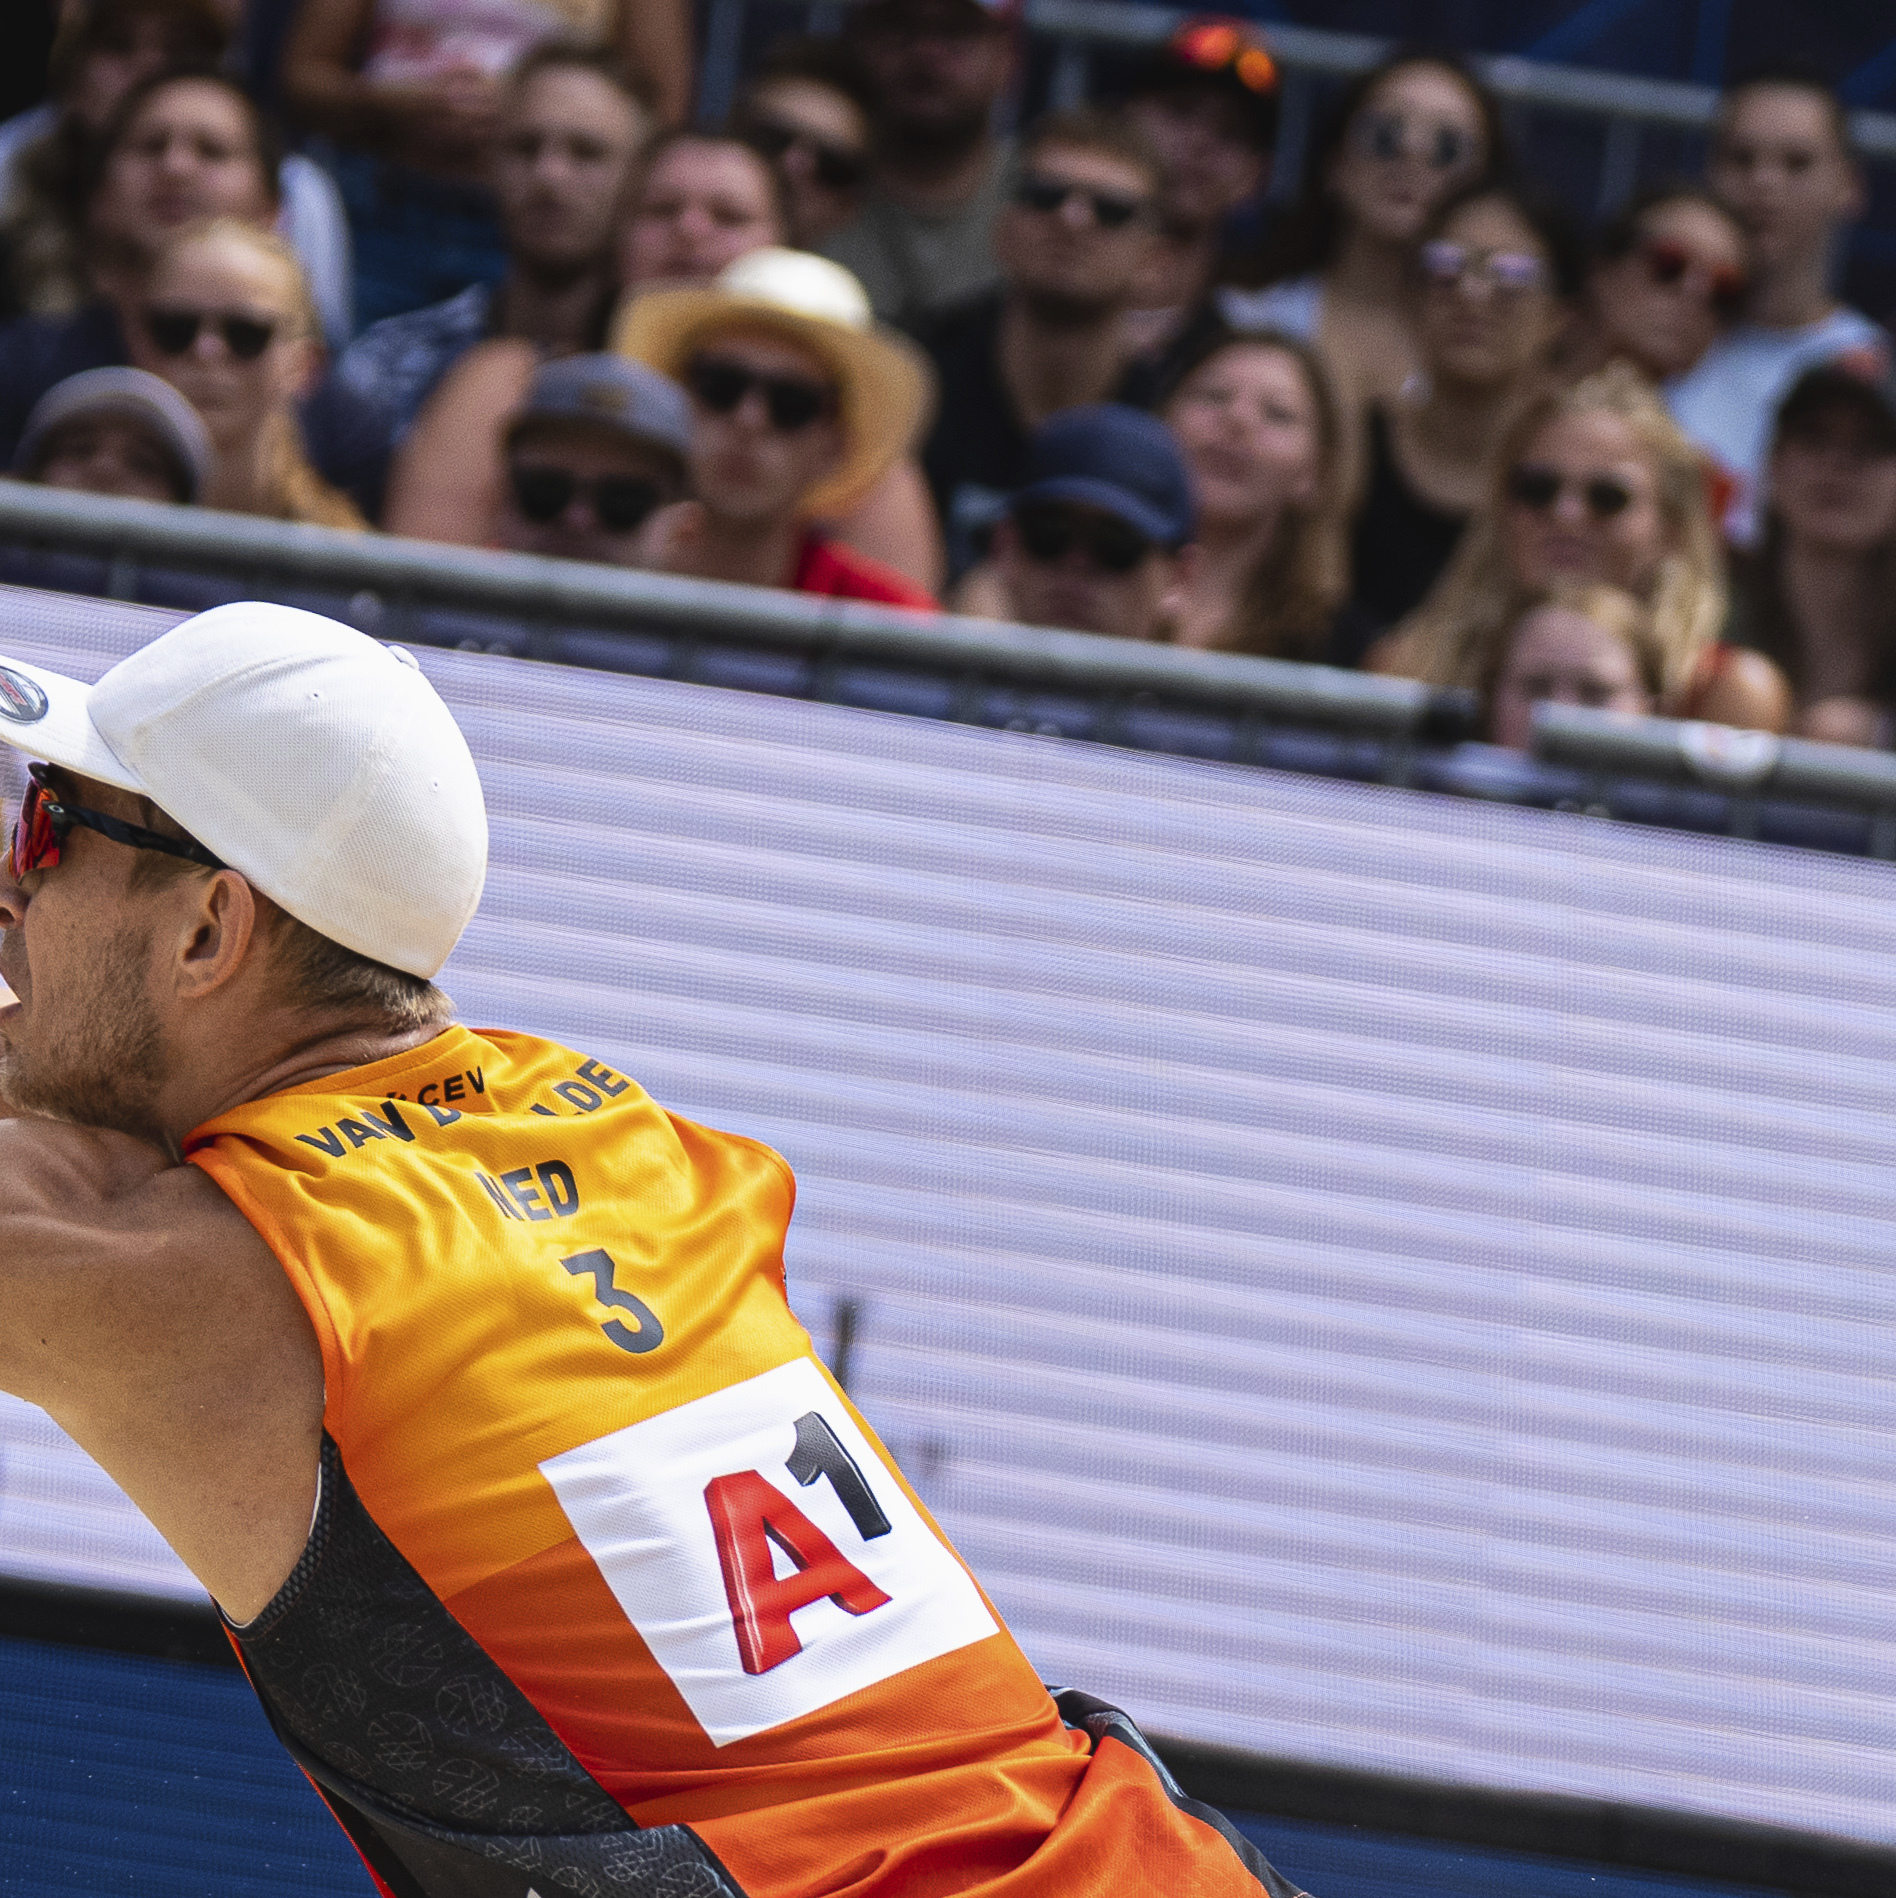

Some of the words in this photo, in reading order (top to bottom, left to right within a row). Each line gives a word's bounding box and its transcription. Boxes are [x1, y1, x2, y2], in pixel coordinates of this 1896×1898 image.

[293, 1100, 417, 1158] VAN
[560, 1248, 665, 1354] 3
[703, 1410, 894, 1676] A1
